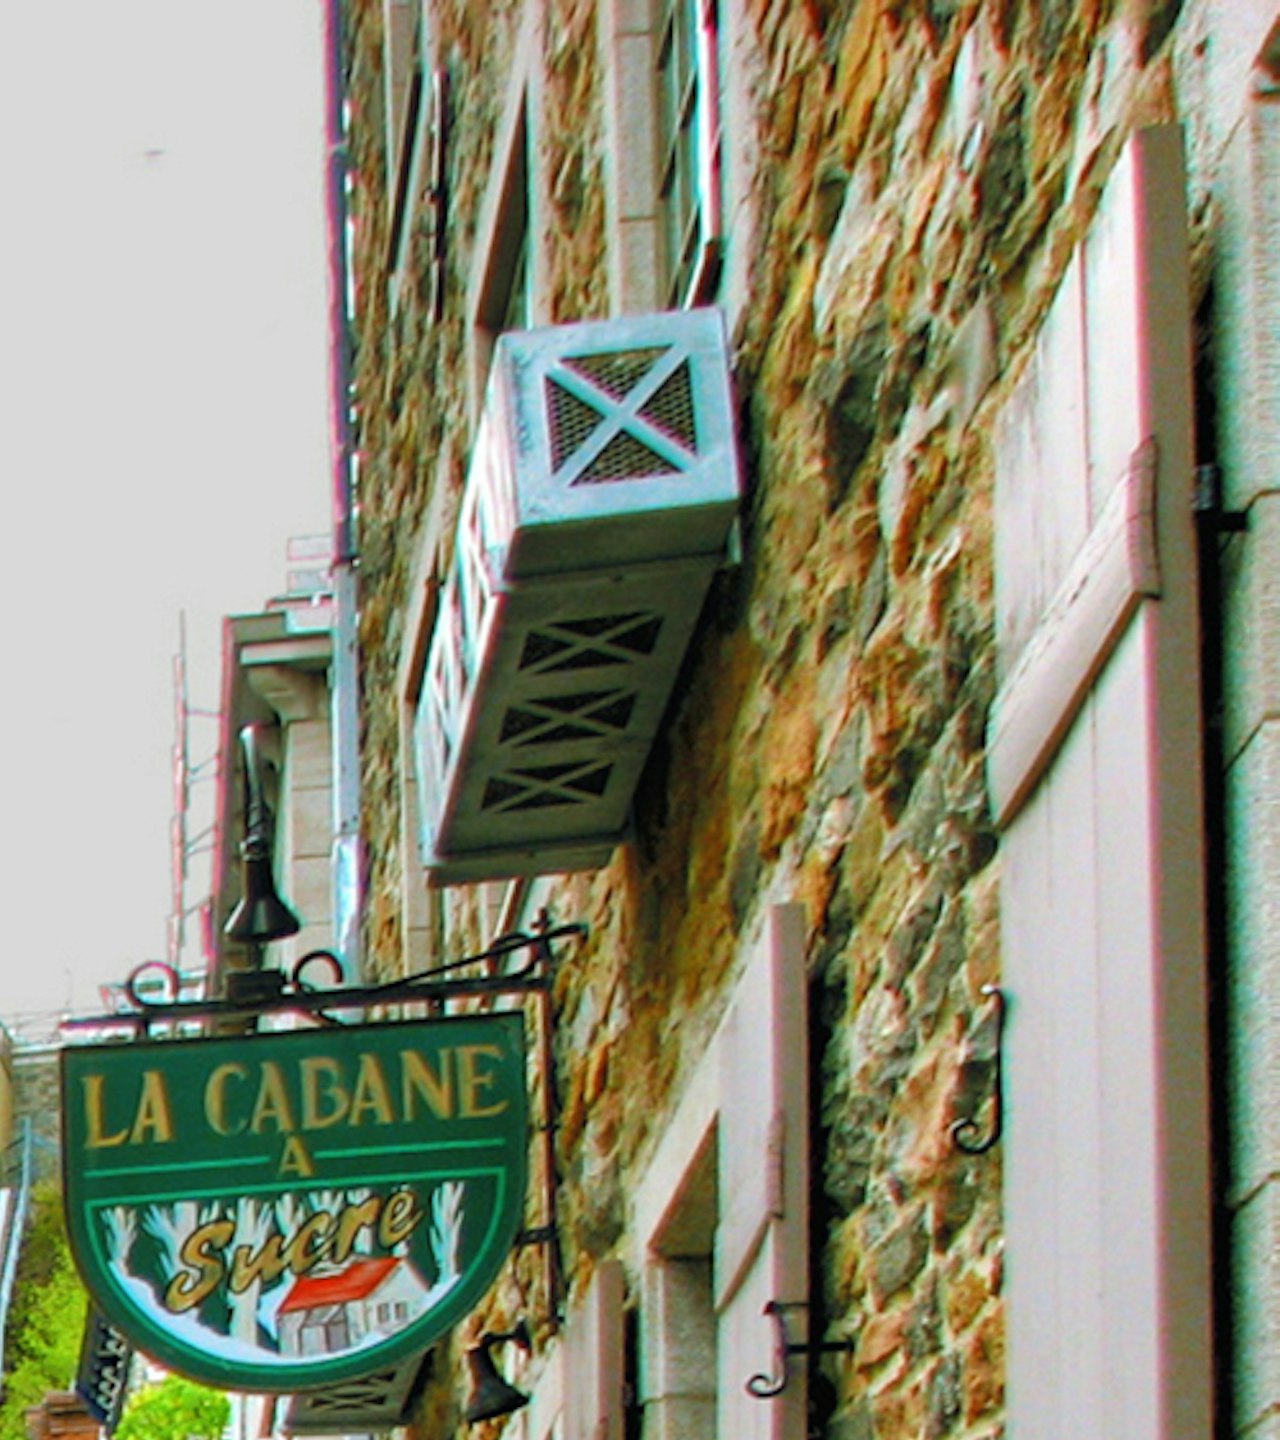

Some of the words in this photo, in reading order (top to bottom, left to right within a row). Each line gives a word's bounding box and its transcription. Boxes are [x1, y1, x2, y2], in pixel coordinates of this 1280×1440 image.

[83, 1069, 175, 1149] LA
[204, 1043, 511, 1137] CABANE
[277, 1136, 316, 1178] A
